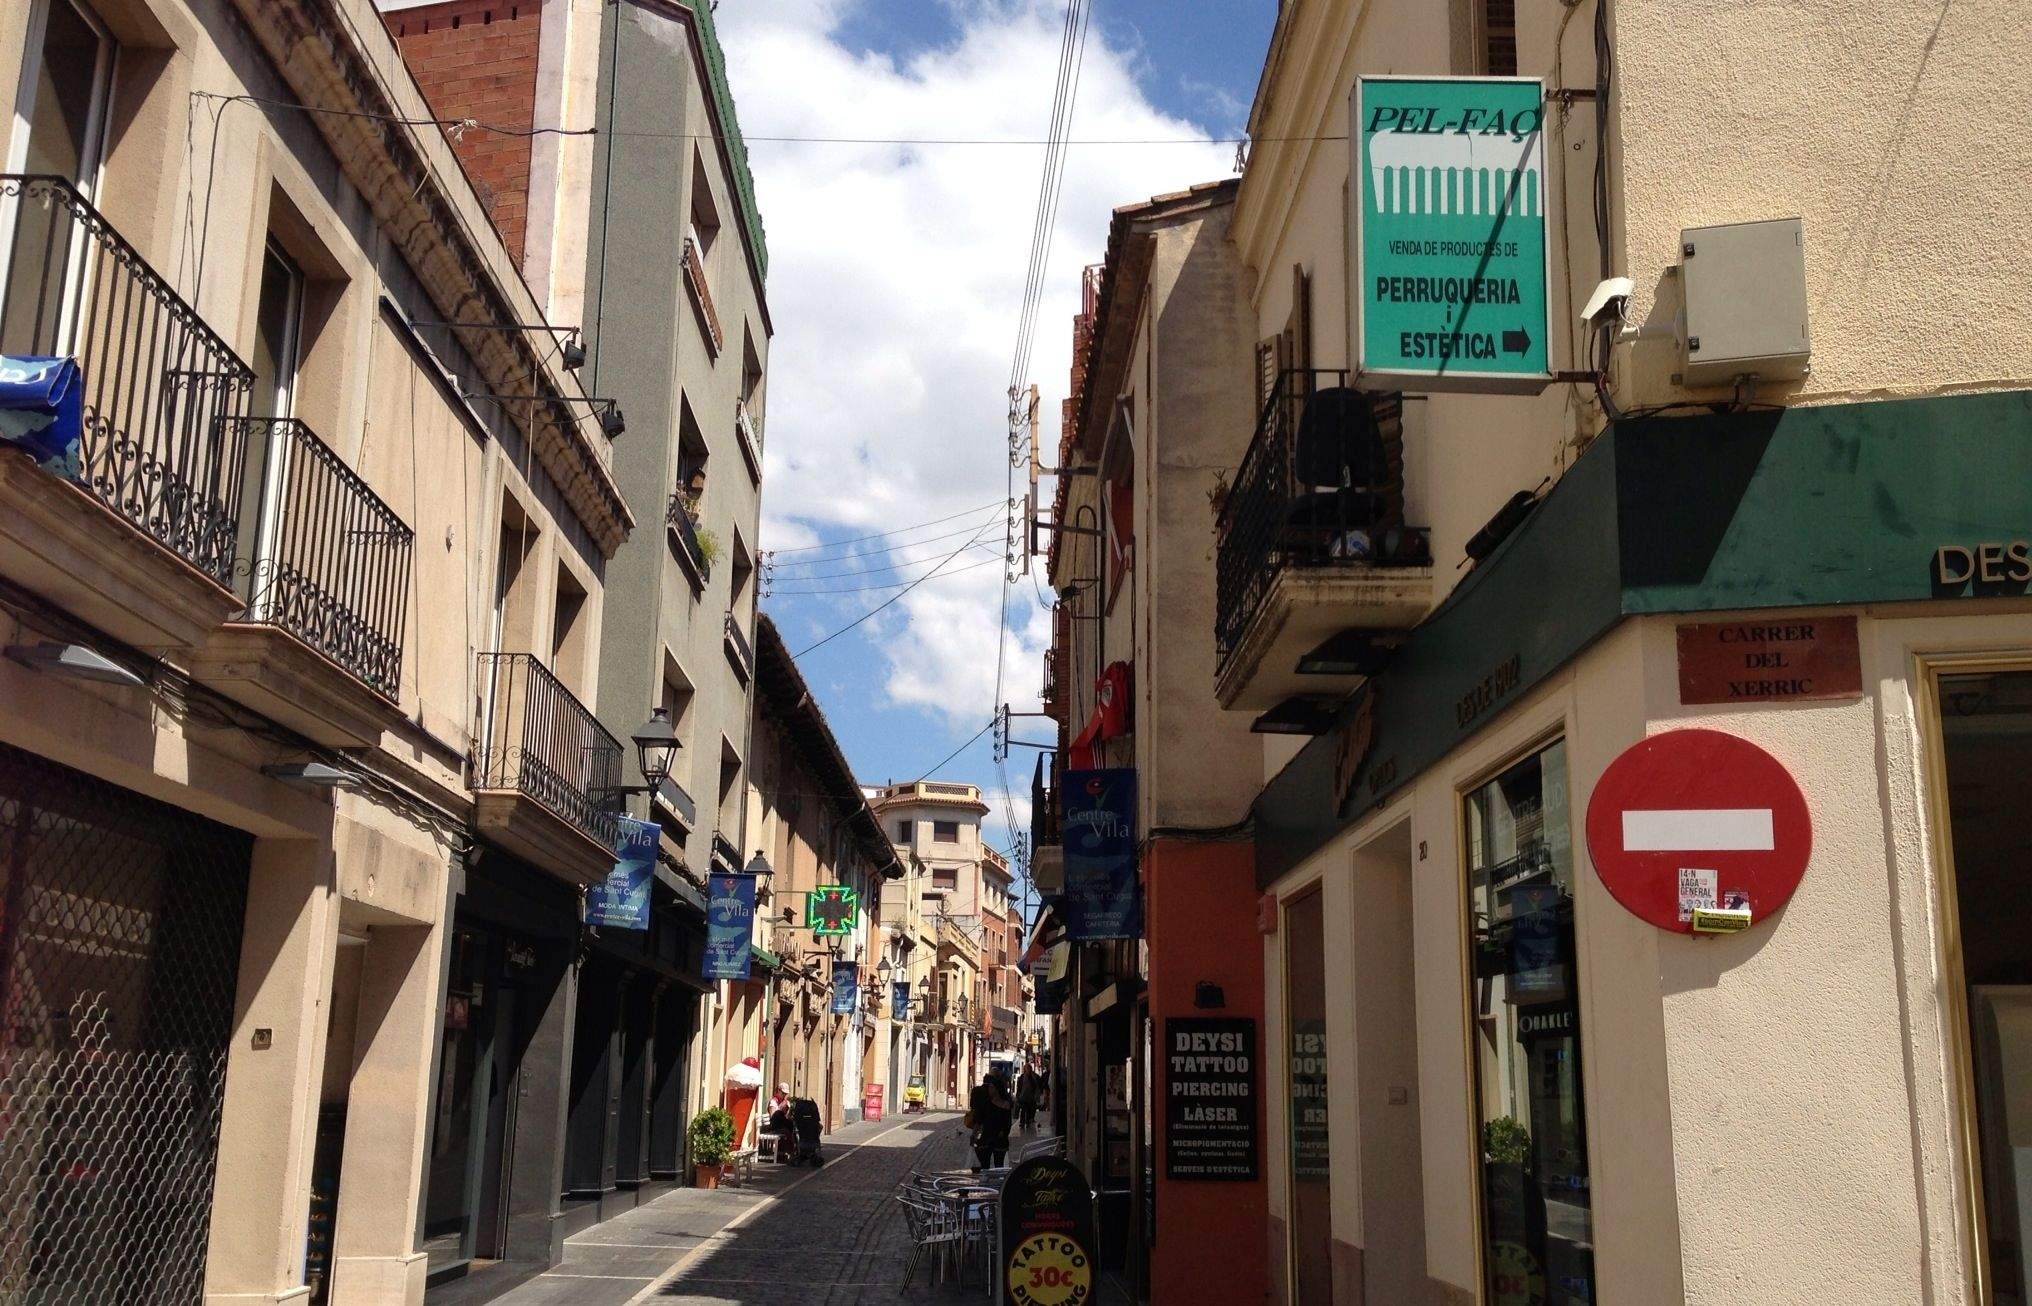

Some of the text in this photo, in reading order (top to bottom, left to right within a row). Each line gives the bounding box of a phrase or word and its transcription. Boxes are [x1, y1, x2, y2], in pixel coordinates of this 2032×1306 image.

[1389, 240, 1519, 257] VENDA DE PRODUCTES DE
[1376, 276, 1521, 304] PERRUQUERIA
[1446, 304, 1452, 323] i
[1400, 326, 1497, 359] ESTÈTICA
[1938, 541, 2032, 584] DES
[1718, 625, 1815, 643] CARRER
[1745, 653, 1789, 669] DEL
[1728, 678, 1813, 697] XERRIC
[1067, 806, 1114, 823] Centre
[1090, 821, 1129, 838] Vila
[620, 830, 651, 847] Vila
[1680, 878, 1700, 887] VAGA
[1680, 887, 1712, 897] GENERAL
[725, 905, 749, 917] Vila
[1176, 1032, 1244, 1053] DEYSI
[1171, 1056, 1249, 1073] TATTOO
[1172, 1081, 1249, 1096] PIERCING
[1184, 1103, 1238, 1121] LÀSER
[1013, 1238, 1086, 1269] TATTOO
